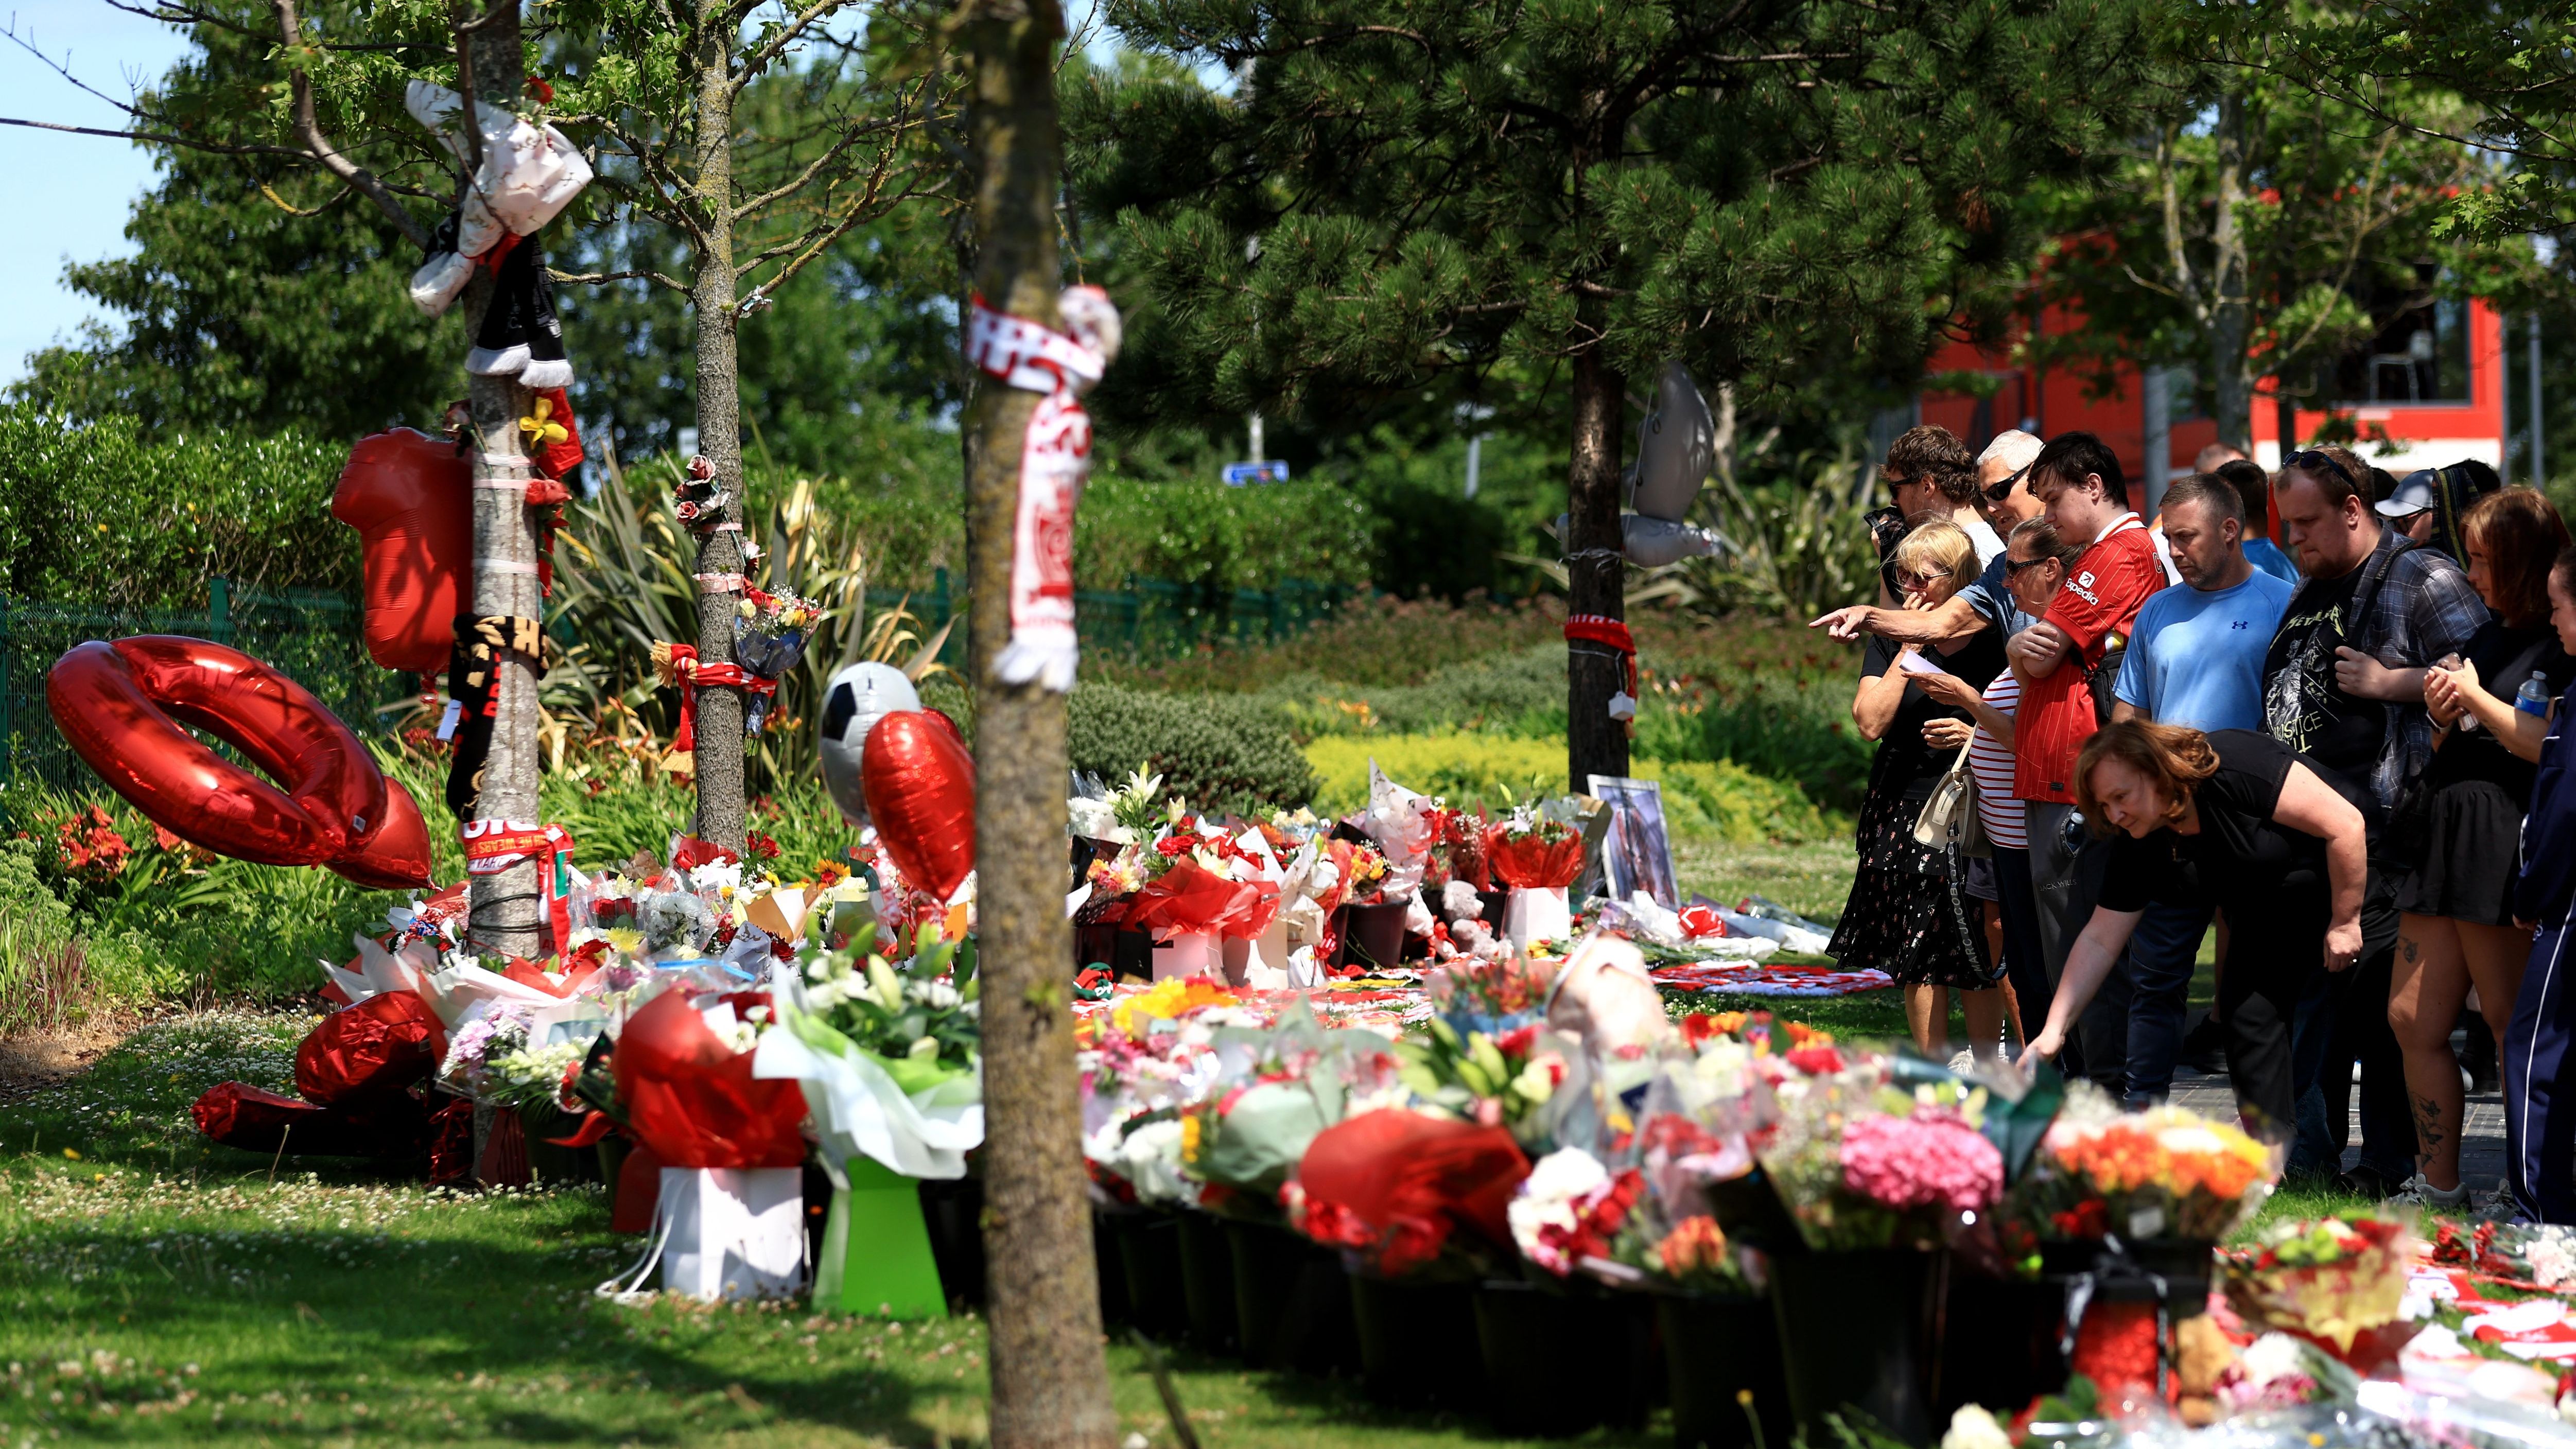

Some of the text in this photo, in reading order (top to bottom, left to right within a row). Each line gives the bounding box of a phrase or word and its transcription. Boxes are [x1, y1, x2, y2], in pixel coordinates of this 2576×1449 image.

[2065, 578, 2099, 605] Expedia
[478, 837, 516, 853] WEARS
[1962, 939, 1982, 972] MARC
